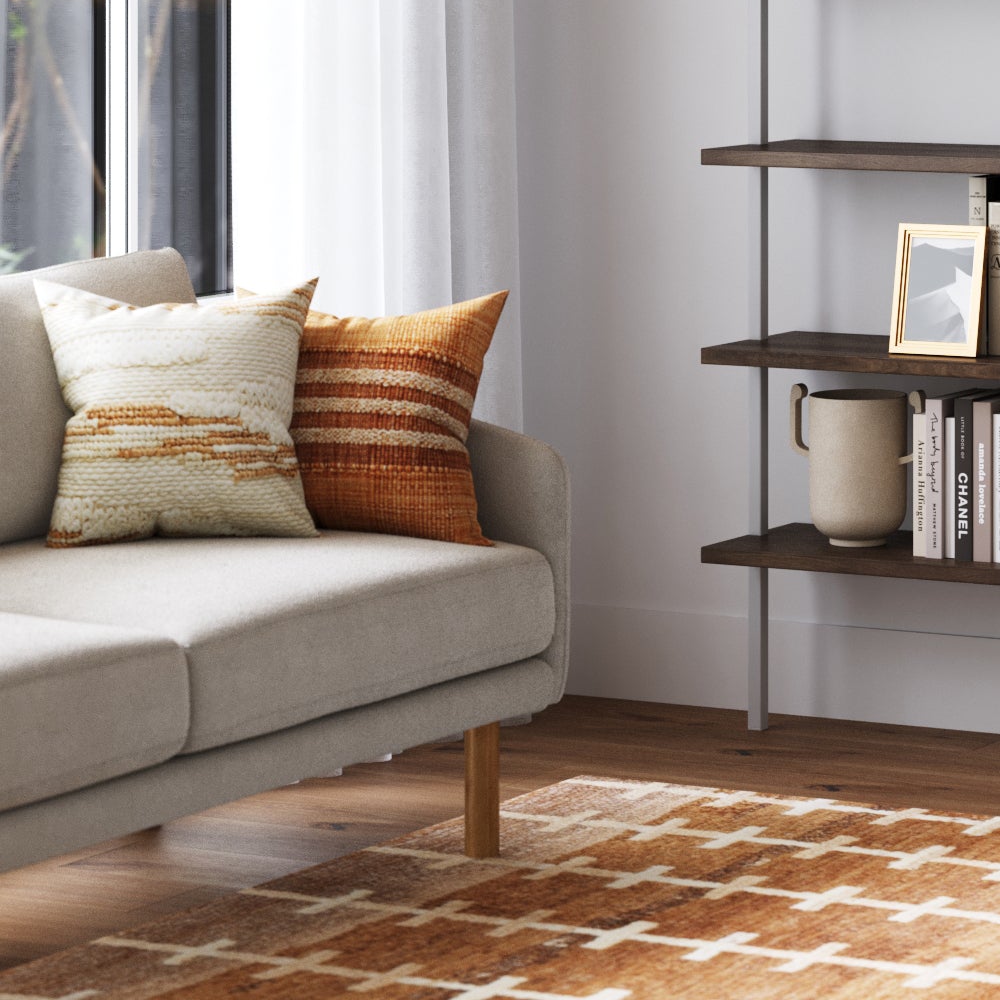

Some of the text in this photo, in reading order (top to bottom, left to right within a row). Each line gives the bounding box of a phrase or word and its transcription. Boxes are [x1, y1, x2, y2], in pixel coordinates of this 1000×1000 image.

[973, 206, 981, 216] N
[931, 412, 939, 432] The
[930, 435, 940, 457] body
[960, 451, 965, 459] OF
[927, 461, 939, 493] beyond
[978, 442, 986, 525] amanda lovelace
[916, 480, 925, 532] Huffington
[958, 472, 968, 540] CHANEL
